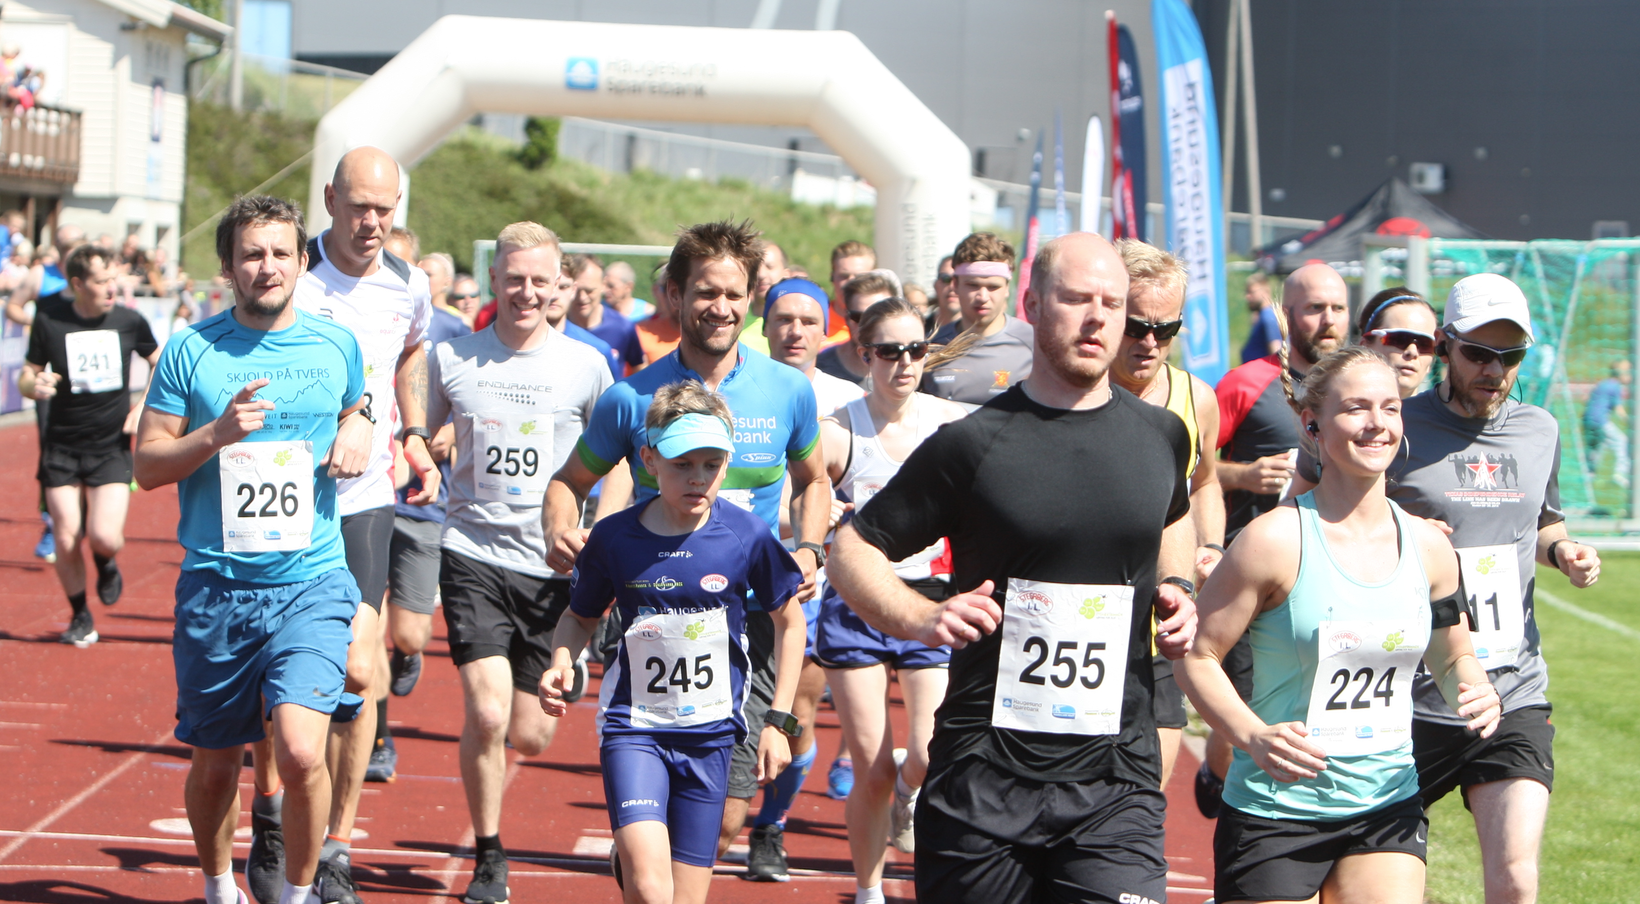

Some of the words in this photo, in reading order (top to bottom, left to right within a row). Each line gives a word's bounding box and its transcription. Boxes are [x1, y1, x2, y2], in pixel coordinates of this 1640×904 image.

[78, 352, 109, 372] 241
[227, 371, 273, 382] SKJOLD
[277, 368, 292, 380] PÅ
[295, 368, 330, 379] TVERS
[477, 380, 553, 393] ENDURANCE
[732, 416, 776, 429] esund
[486, 445, 539, 477] 259
[237, 481, 298, 518] 226
[1469, 592, 1500, 632] 11
[645, 653, 714, 693] 245
[1019, 636, 1106, 690] 255
[1325, 666, 1397, 711] 224
[622, 799, 653, 808] CRAFT
